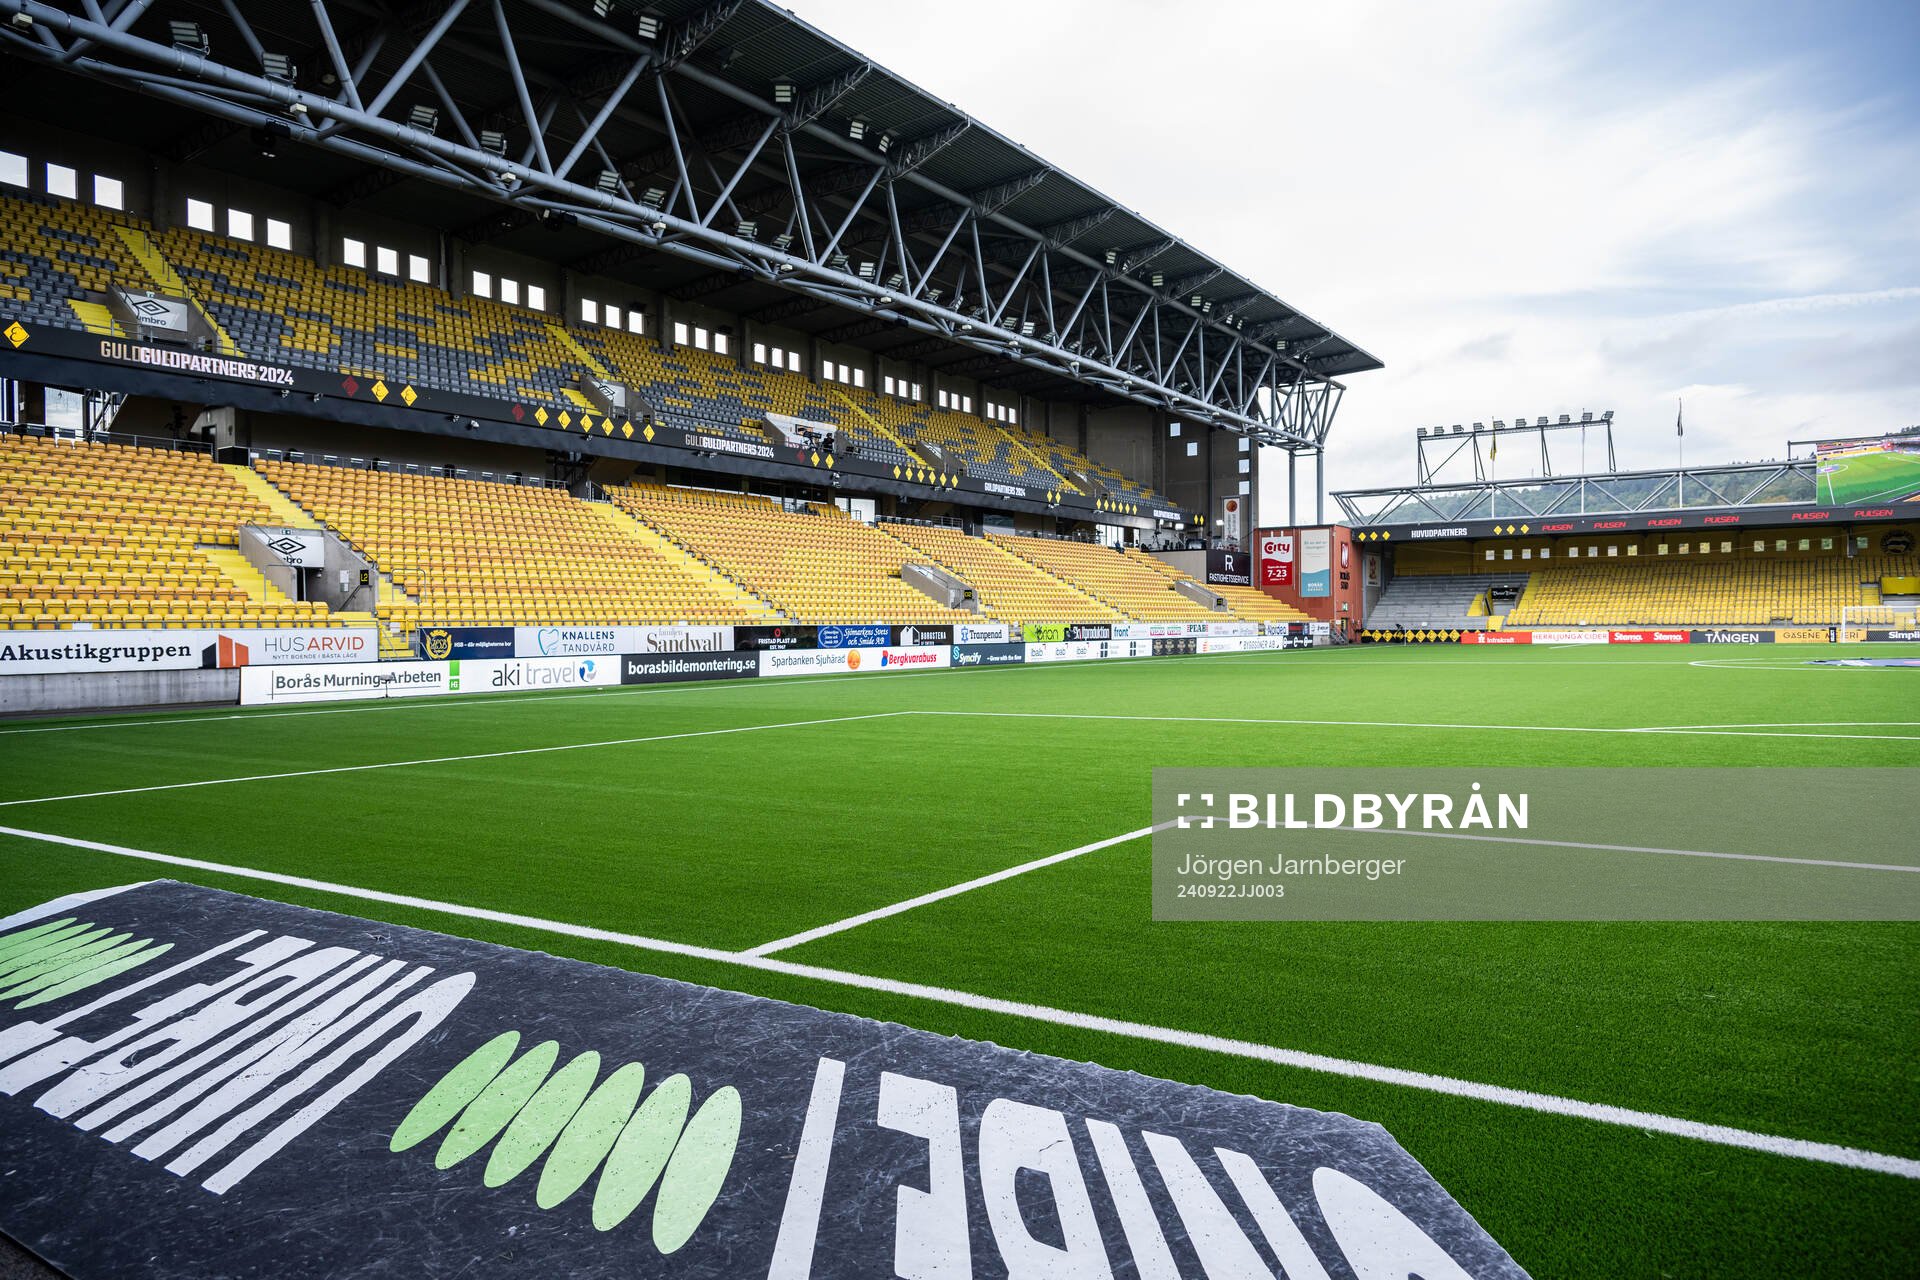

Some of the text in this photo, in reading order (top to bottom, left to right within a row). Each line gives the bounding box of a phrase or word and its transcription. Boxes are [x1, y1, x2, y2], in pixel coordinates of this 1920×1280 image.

[140, 346, 256, 380] GULDPARTNERS
[259, 365, 294, 385] 2024
[703, 437, 757, 456] GULDPARTNERS
[757, 445, 774, 459] 2024
[1791, 512, 1829, 520] PULSEN
[1854, 509, 1894, 518] PULSEN
[1593, 521, 1627, 529] PULSEN
[1704, 516, 1740, 524] PULSEN
[1542, 523, 1574, 531] PULSEN
[1411, 528, 1467, 538] HUVUDPARTNERS
[360, 573, 369, 582] L2
[1209, 573, 1249, 584] FASTIGHETSSERVICE
[1267, 570, 1287, 578] 7-23
[562, 630, 615, 640] KNALLENS
[1705, 631, 1759, 643] TÅNGEN
[562, 641, 615, 653] TANDVÅRD
[646, 631, 723, 652] Sandwall
[0, 642, 191, 663] Akustikgruppen
[771, 653, 846, 667] Sparbanken Sjuhärad
[628, 658, 756, 675] borasbildemontering.se
[492, 660, 576, 687] aki travel
[275, 673, 321, 689] Borås
